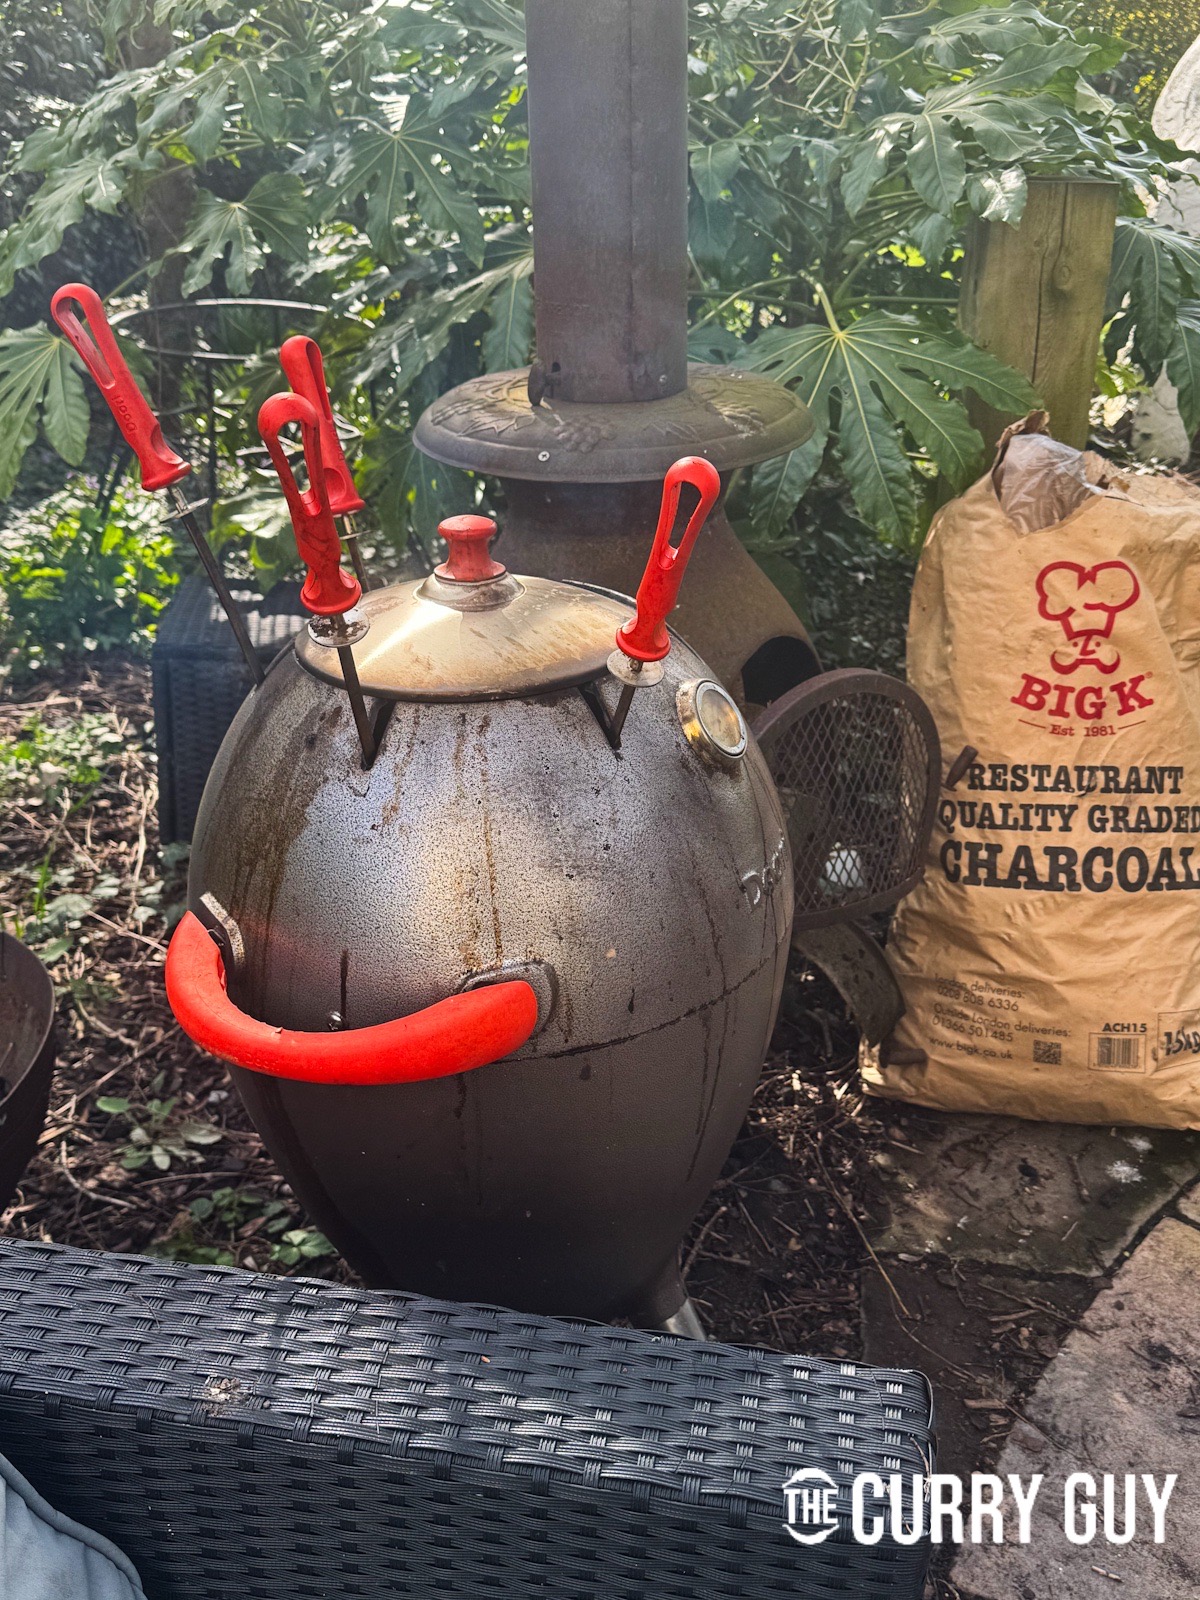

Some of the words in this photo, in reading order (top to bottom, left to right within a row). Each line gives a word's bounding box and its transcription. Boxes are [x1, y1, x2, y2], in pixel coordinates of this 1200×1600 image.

[1049, 724, 1075, 737] Est
[1084, 725, 1116, 737] 1981
[967, 763, 1184, 795] RESTAURANT
[939, 800, 1078, 833] QUALITY
[1087, 805, 1200, 833] GRADED
[940, 839, 1200, 892] CHARCOAL
[963, 991, 984, 1006] 808
[988, 998, 1019, 1012] 6336
[972, 1012, 1010, 1030] London
[1014, 1020, 1071, 1037] deliveries:
[1102, 1022, 1148, 1033] ACH15
